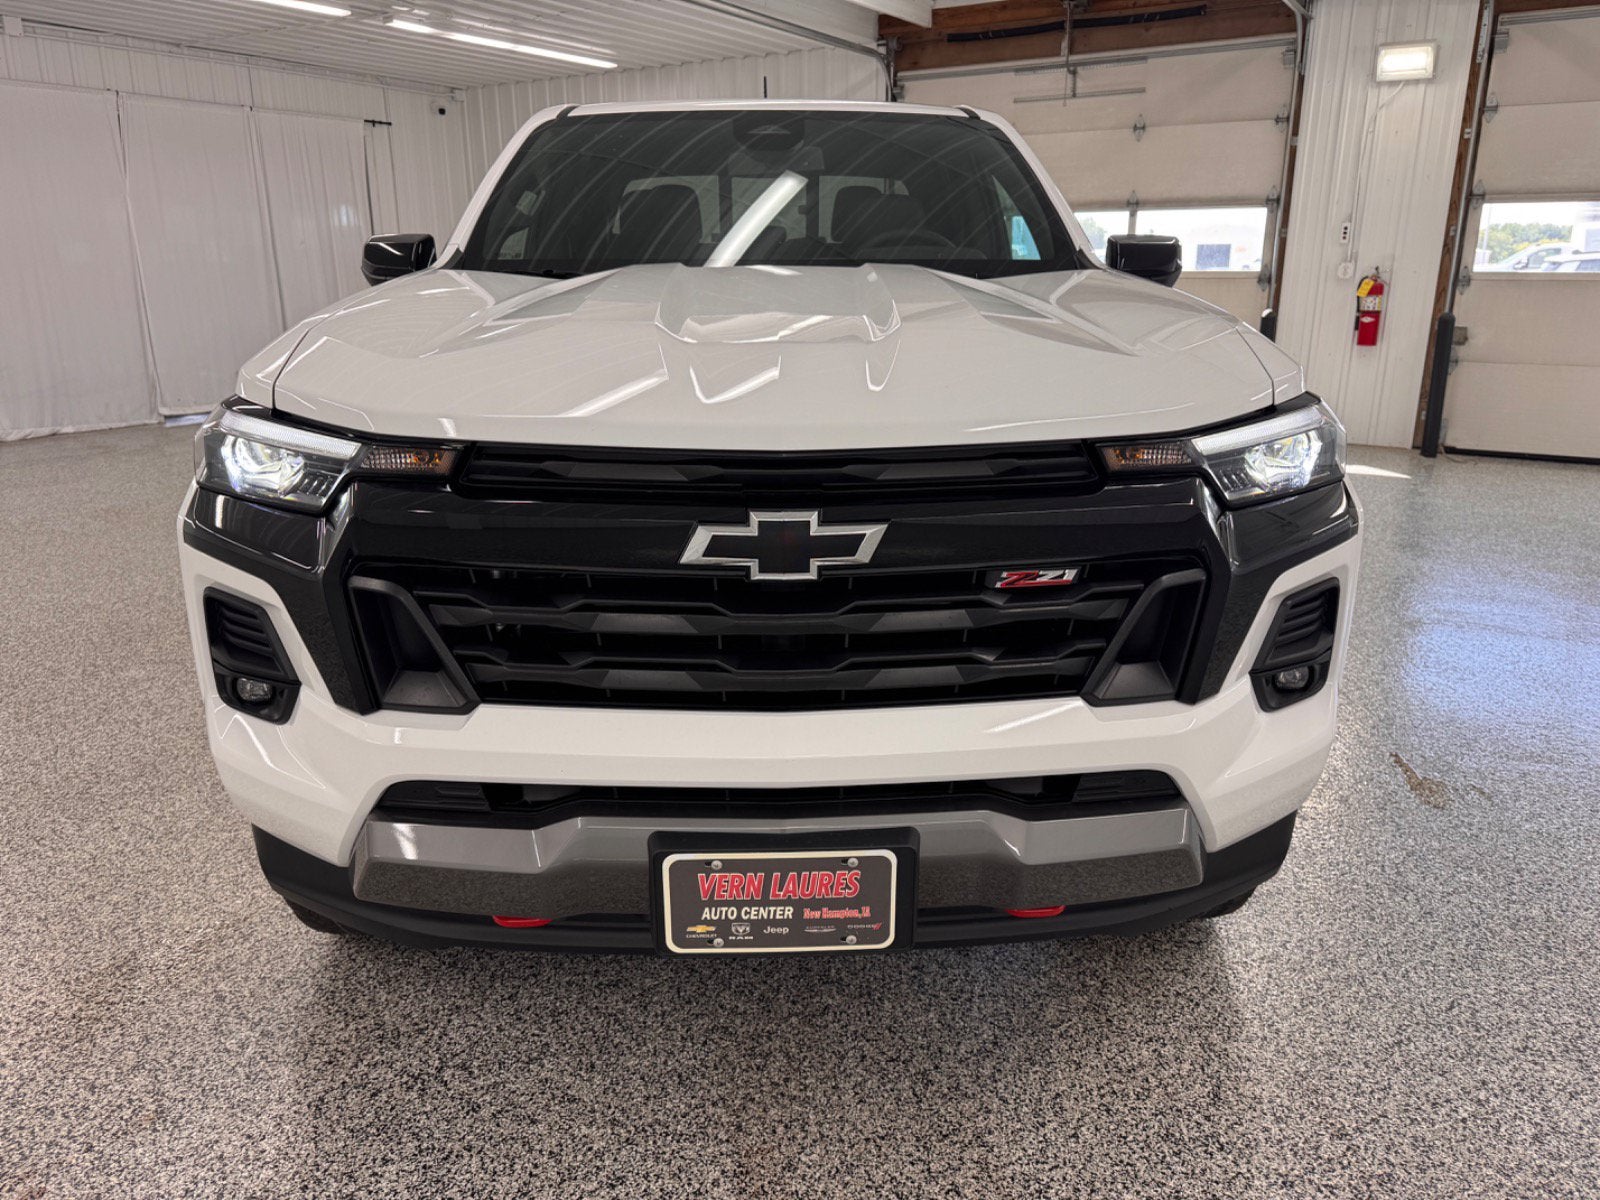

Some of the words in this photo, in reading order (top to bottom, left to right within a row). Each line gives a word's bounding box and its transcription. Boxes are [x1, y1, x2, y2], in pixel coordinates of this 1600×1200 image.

[698, 872, 764, 901] VERN
[770, 870, 861, 900] LAURES
[701, 906, 737, 920] AUTO
[741, 905, 794, 920] CENTER
[763, 925, 789, 935] Jeep
